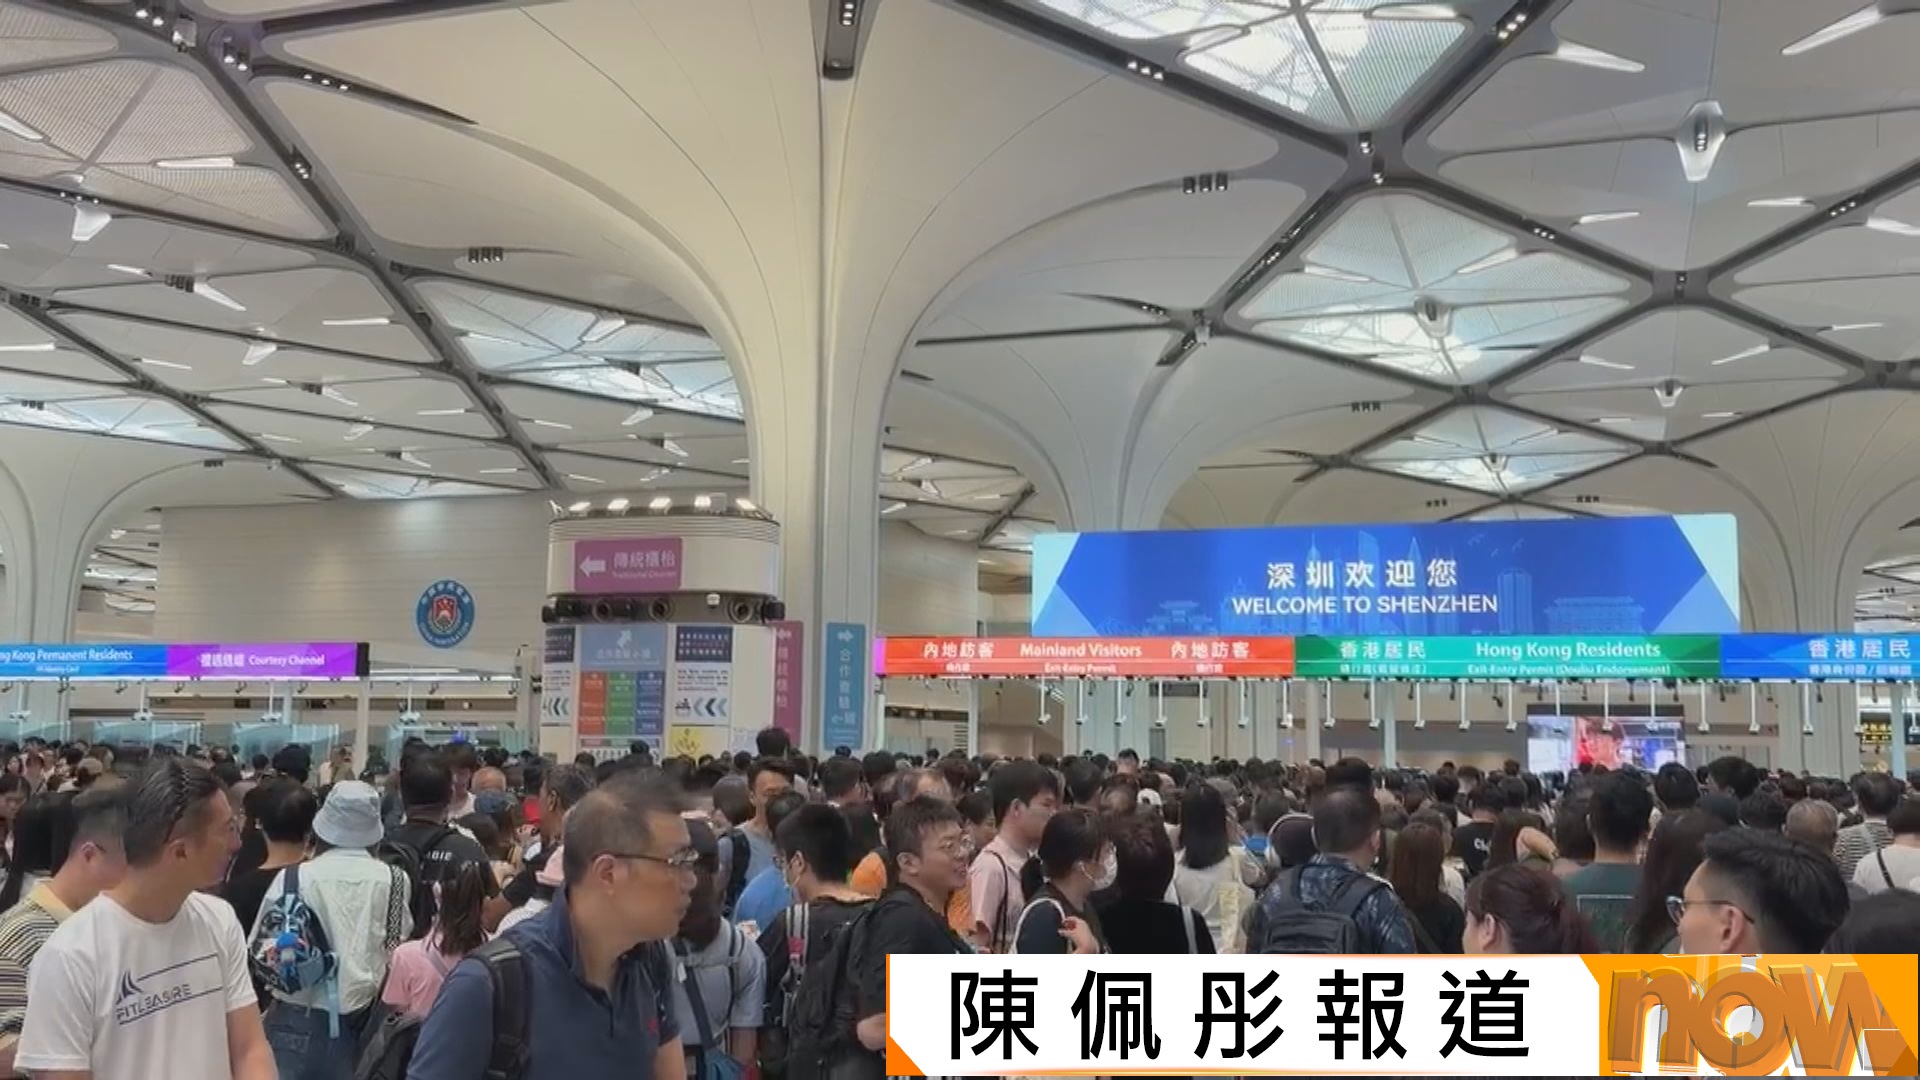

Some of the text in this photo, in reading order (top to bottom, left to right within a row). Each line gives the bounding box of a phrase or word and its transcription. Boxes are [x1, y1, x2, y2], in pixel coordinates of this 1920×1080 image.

[1267, 559, 1457, 589] 深圳欢迎您
[1232, 594, 1498, 615] WELCOME TO SHENZHEN
[12, 650, 35, 663] Kong
[36, 649, 87, 661] Permanent
[88, 648, 133, 661] Residents
[1020, 643, 1142, 657] Mainland Visitors
[1340, 640, 1427, 660] 香港居民
[1476, 642, 1661, 660] Hong Kong Residents
[1808, 639, 1911, 659] 香港居民
[249, 654, 325, 668] Courtesy Channel
[1520, 664, 1553, 675] Permit
